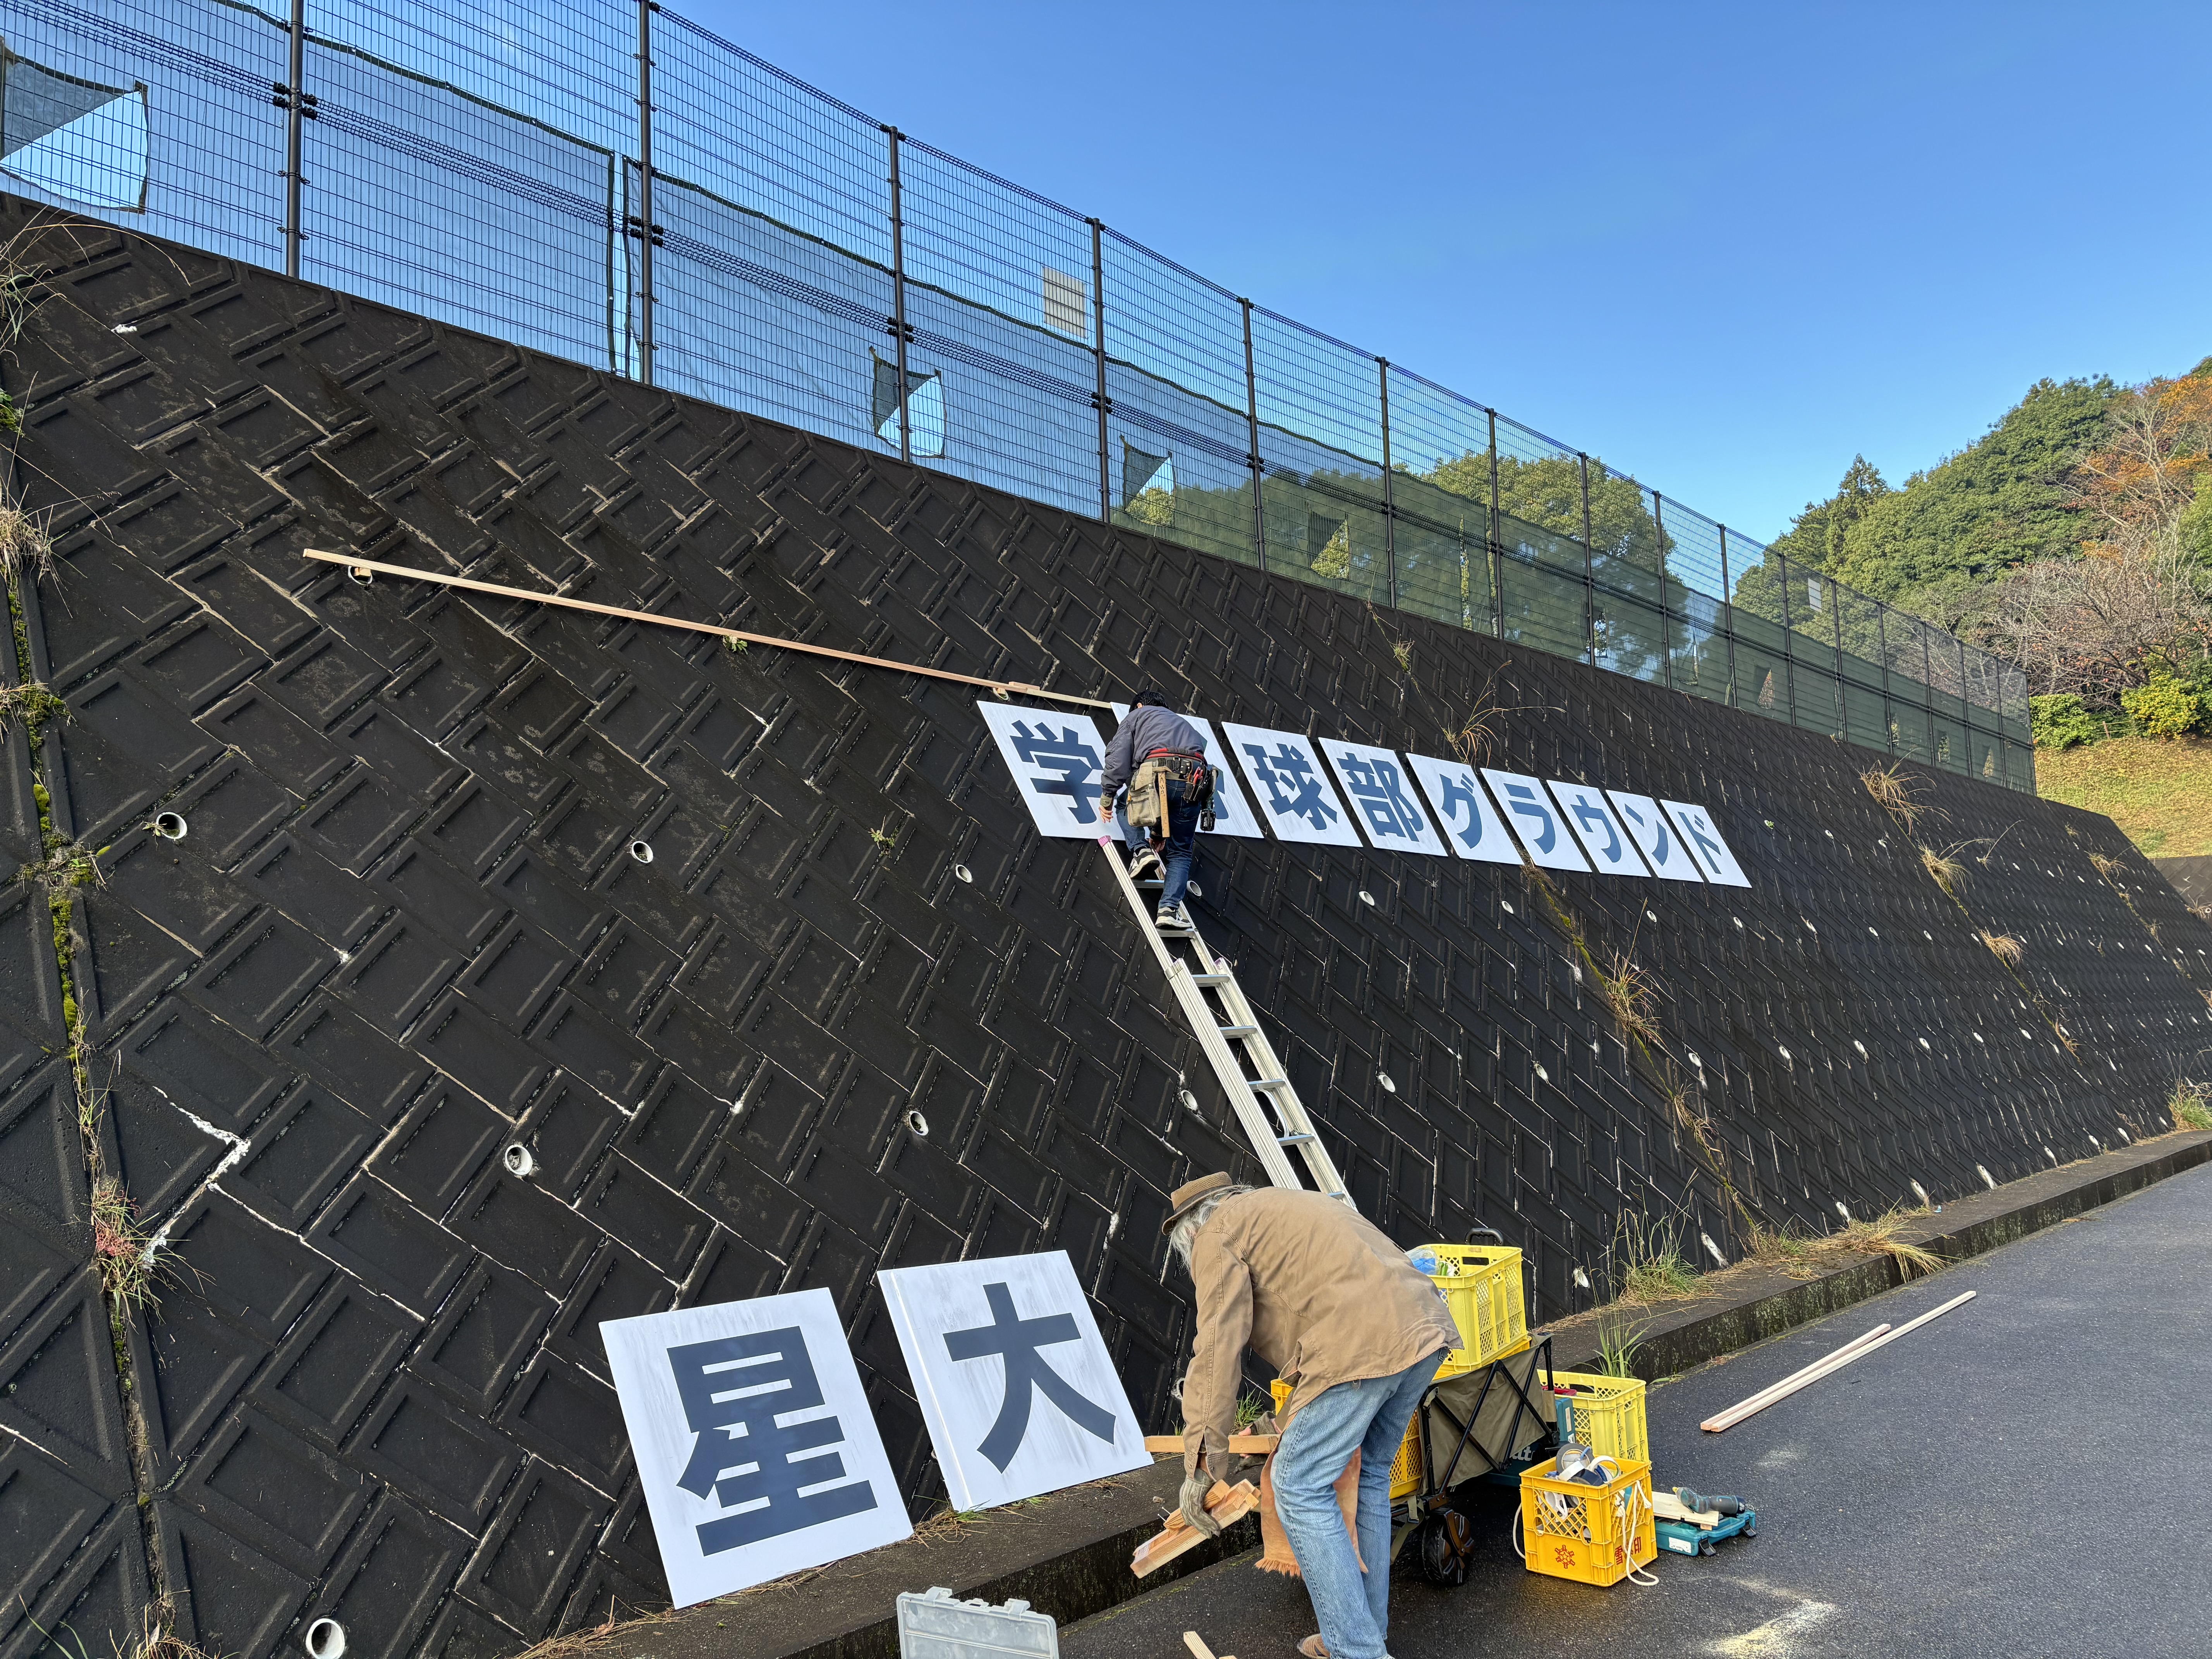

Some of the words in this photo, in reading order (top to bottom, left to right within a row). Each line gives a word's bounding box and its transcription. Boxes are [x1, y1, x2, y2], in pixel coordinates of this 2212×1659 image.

[1009, 720, 1722, 874] 学球部グラウンド
[666, 1326, 878, 1557] 星
[942, 1282, 1116, 1474] 大
